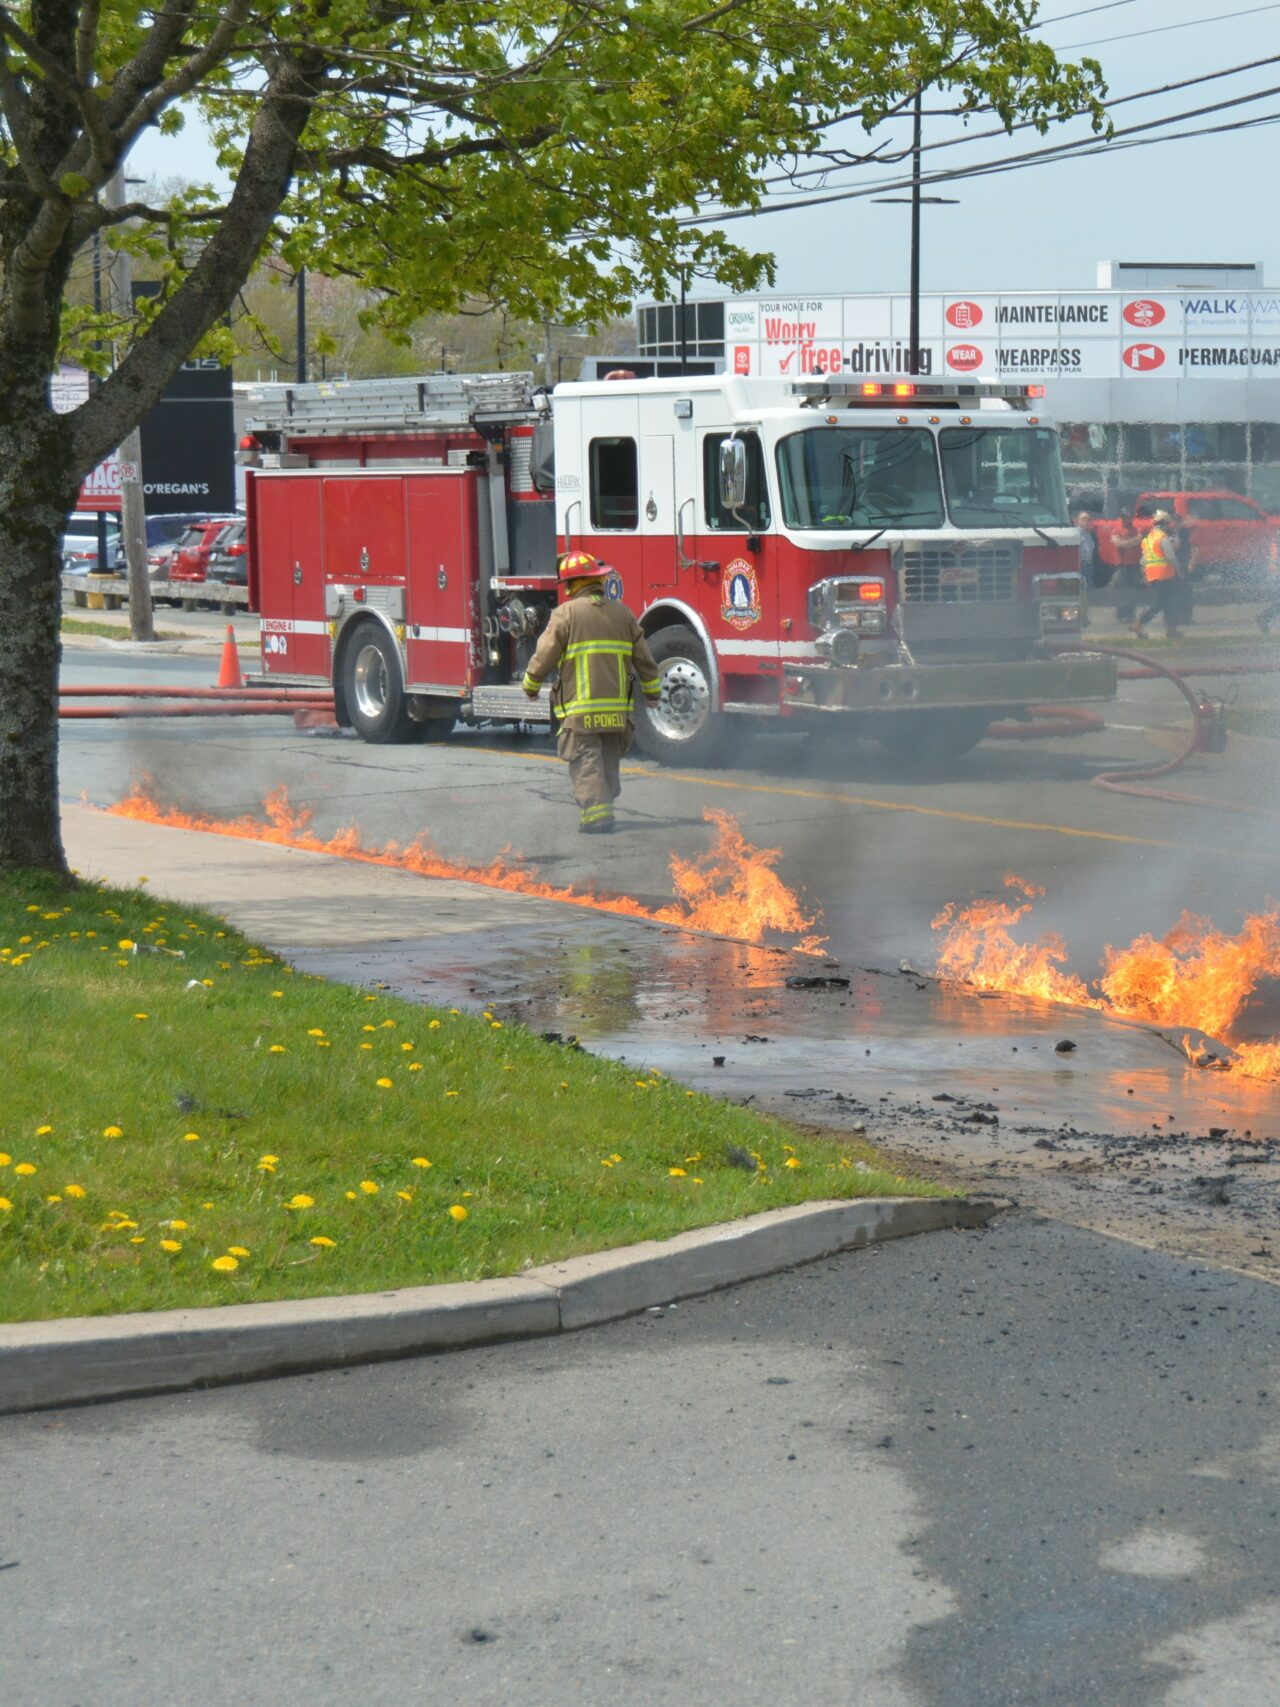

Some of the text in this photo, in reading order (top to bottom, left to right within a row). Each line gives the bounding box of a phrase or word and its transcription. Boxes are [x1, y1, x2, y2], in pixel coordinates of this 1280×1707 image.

[760, 301, 823, 313] YOUR HOME FOR
[995, 305, 1108, 323] MAINTENANCE
[765, 318, 816, 348] Worry
[951, 349, 976, 361] WEAR
[995, 348, 1081, 366] WEARPASS
[143, 483, 210, 495] O'REGAN'S
[610, 582, 617, 597] 4
[265, 620, 292, 631] ENGINE 4
[584, 713, 625, 729] R POWELL
